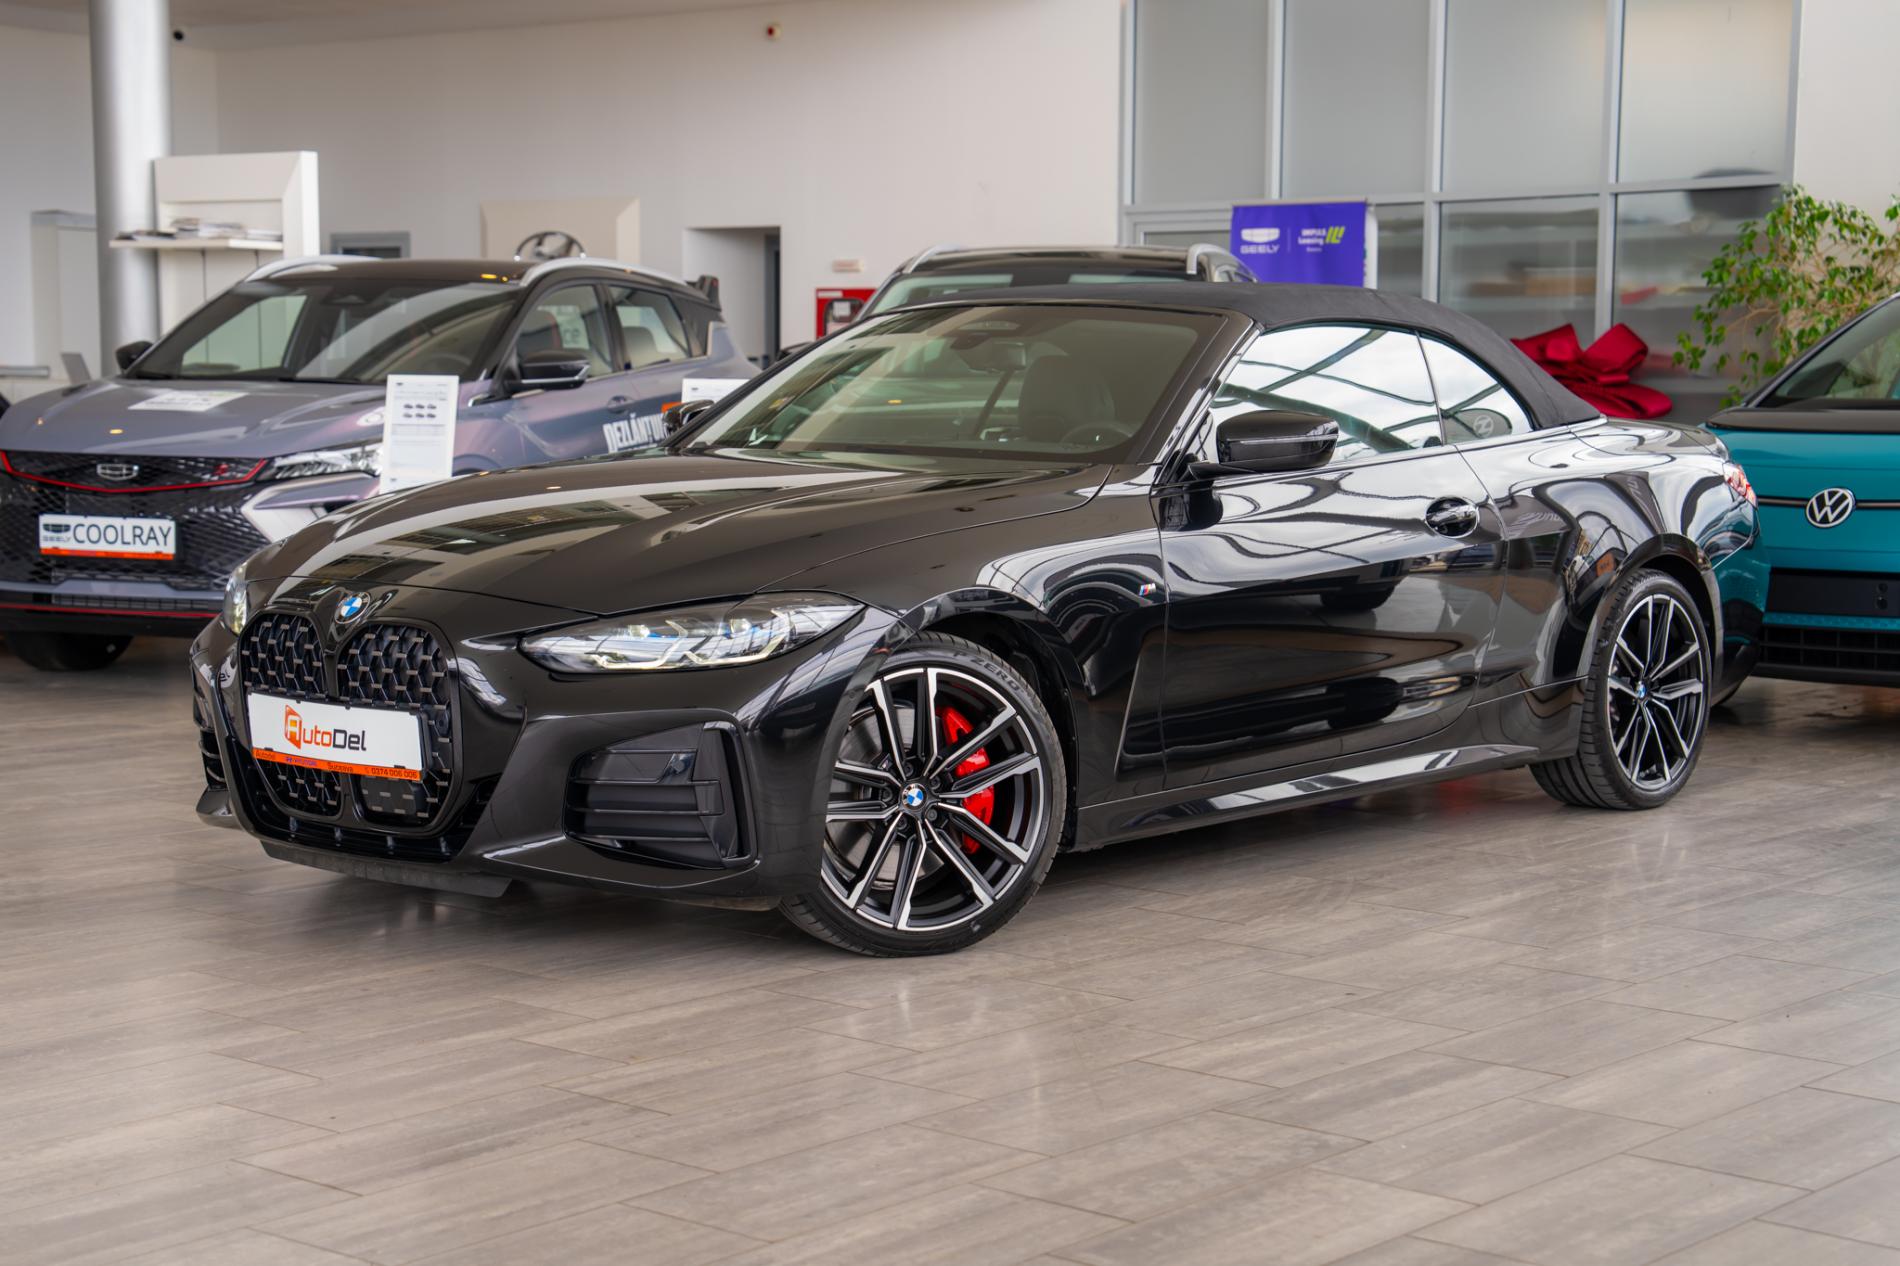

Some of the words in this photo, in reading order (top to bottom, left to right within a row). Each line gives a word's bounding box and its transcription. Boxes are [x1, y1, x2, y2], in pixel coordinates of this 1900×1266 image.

[1240, 244, 1280, 254] GEELY
[73, 524, 171, 546] COOLRAY
[970, 657, 1020, 690] ZERO
[285, 704, 367, 751] AutoDel
